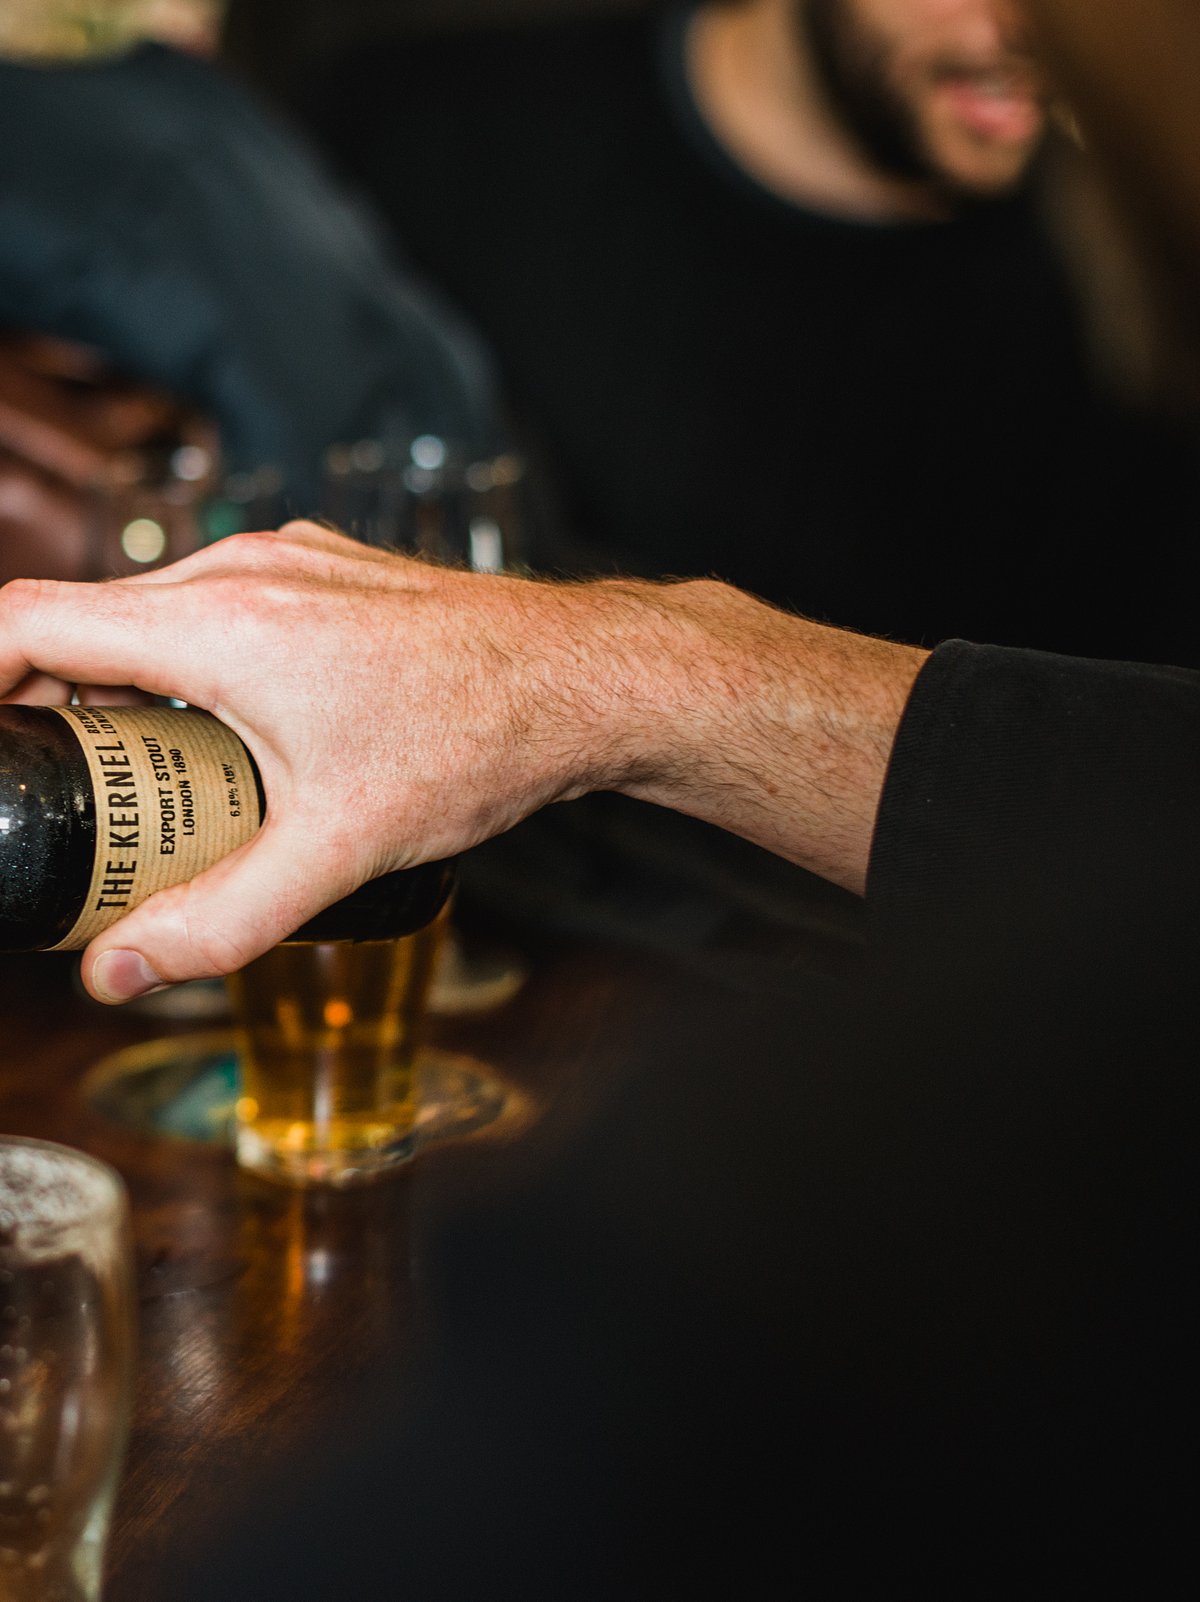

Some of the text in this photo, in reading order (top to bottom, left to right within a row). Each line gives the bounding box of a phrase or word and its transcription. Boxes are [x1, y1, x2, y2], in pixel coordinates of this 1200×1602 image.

[95, 740, 139, 911] THE KERNEL
[141, 735, 176, 855] EXPORT STOUT
[169, 748, 195, 836] LONDON 1890
[221, 763, 241, 817] 6.8% ABV
